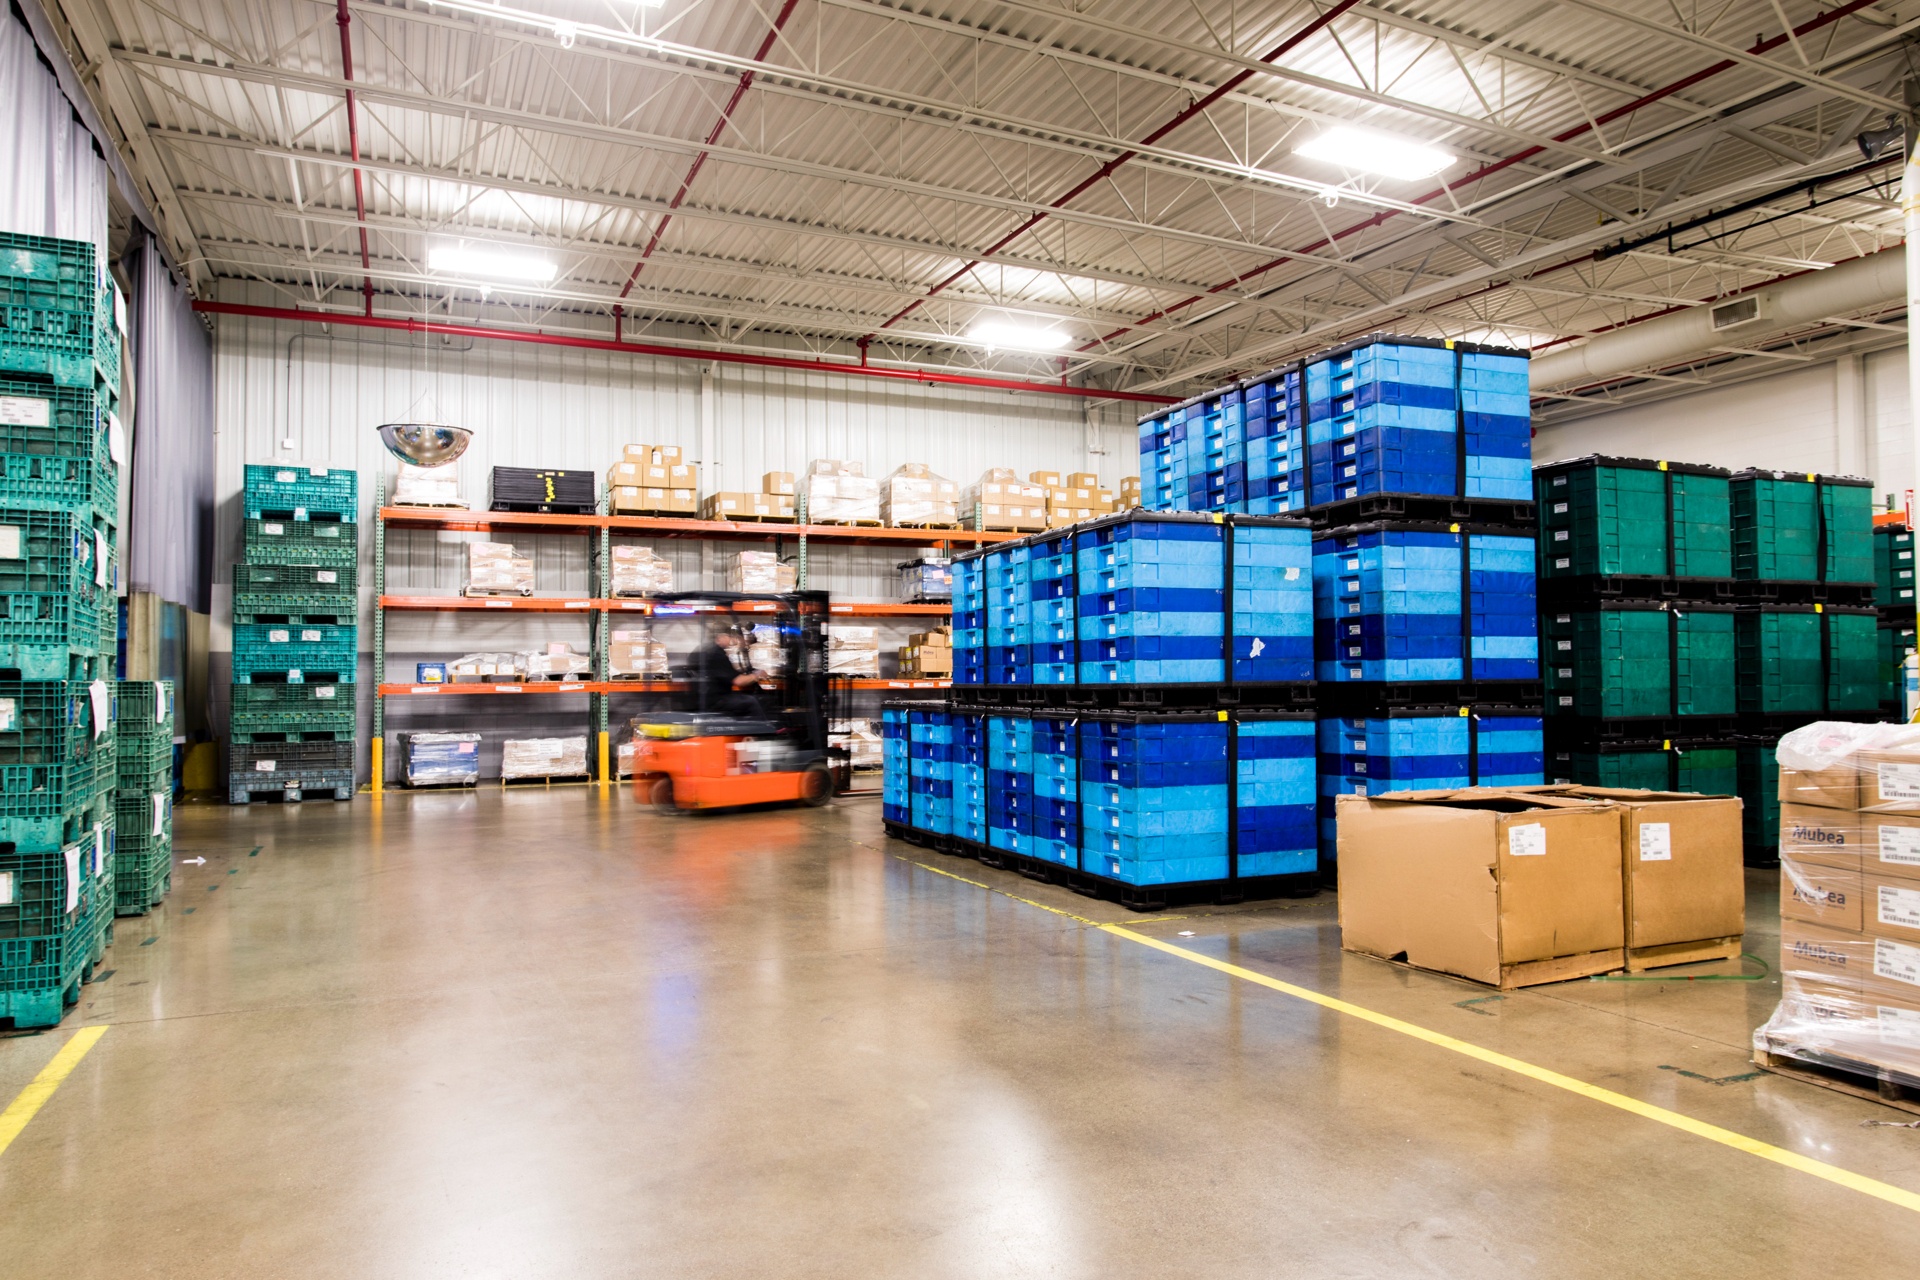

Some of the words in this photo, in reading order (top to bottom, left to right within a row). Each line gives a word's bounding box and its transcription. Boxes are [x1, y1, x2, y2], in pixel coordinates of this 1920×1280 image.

[1792, 825, 1845, 845] Mubea
[1793, 884, 1846, 905] bea
[1794, 940, 1847, 964] Mubea
